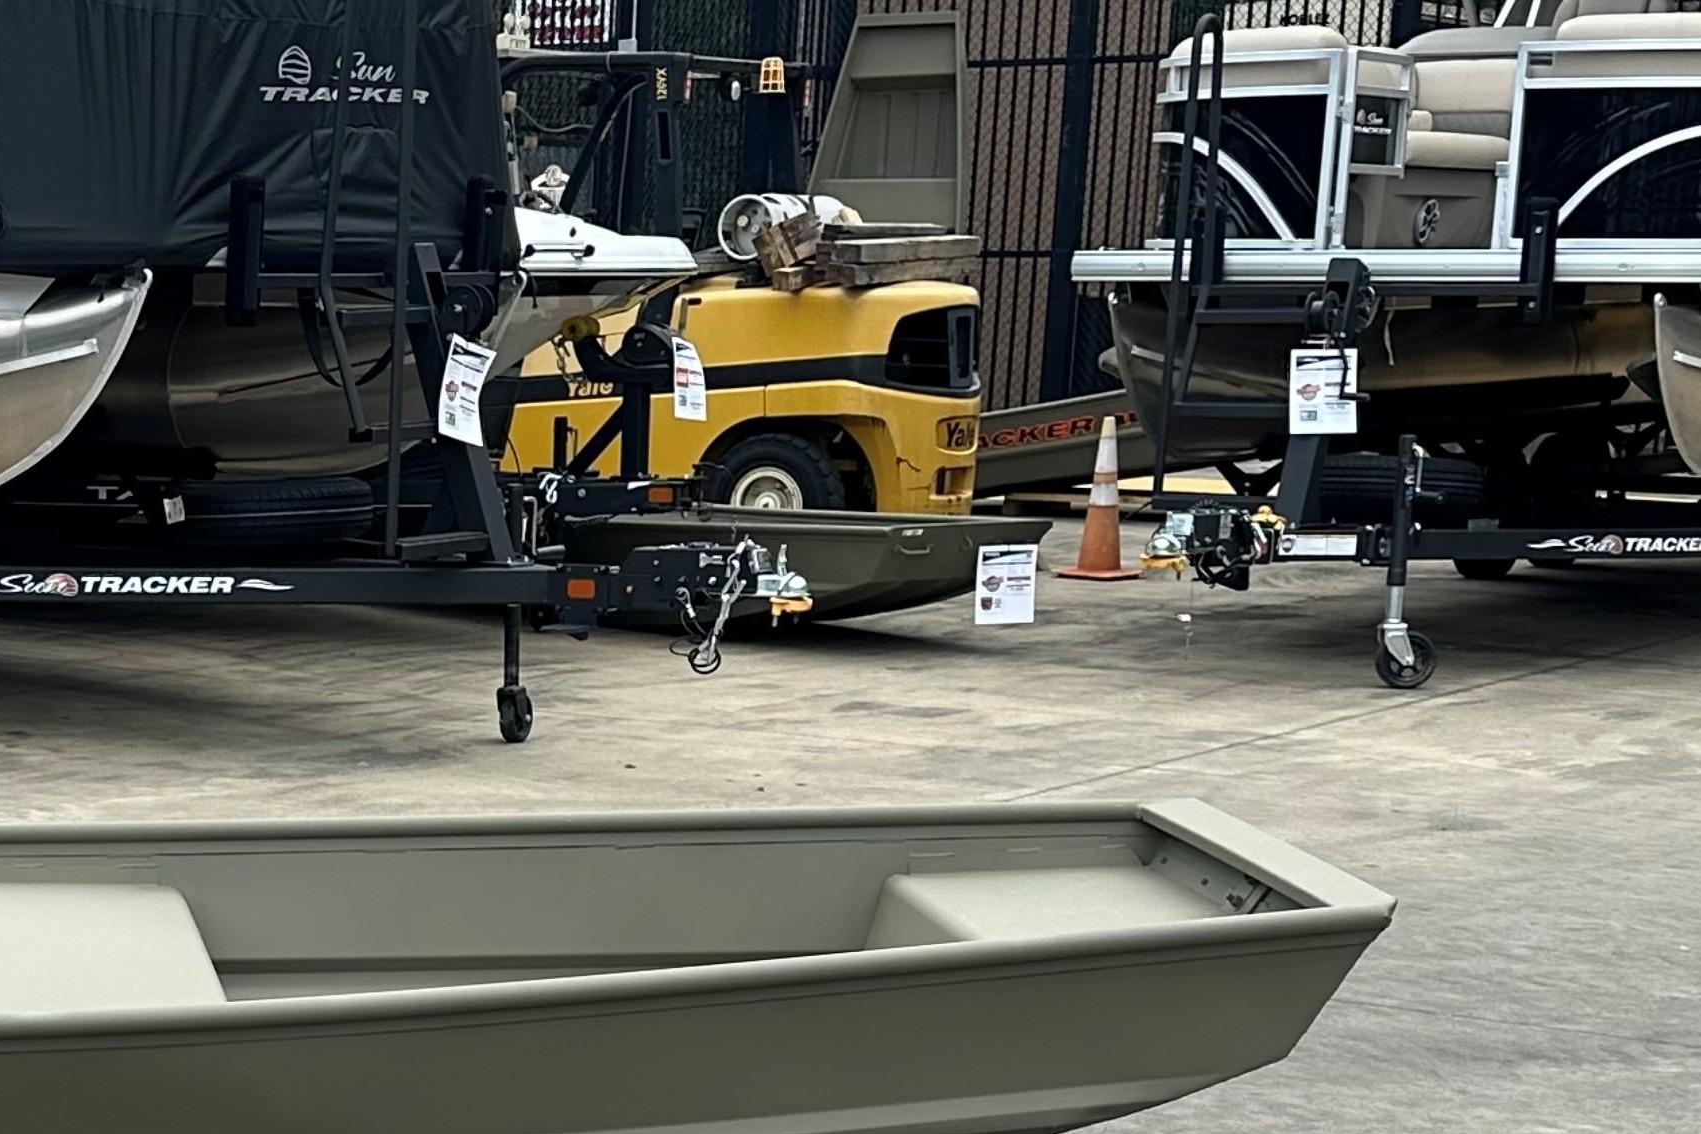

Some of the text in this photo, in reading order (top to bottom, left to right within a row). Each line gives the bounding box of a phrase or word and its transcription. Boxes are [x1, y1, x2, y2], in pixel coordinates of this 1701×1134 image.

[330, 51, 396, 82] Sun
[259, 86, 429, 104] TRACKER
[978, 416, 1096, 449] ACKER
[1626, 537, 1701, 552] TRACKE
[81, 576, 235, 594] TRACKER
